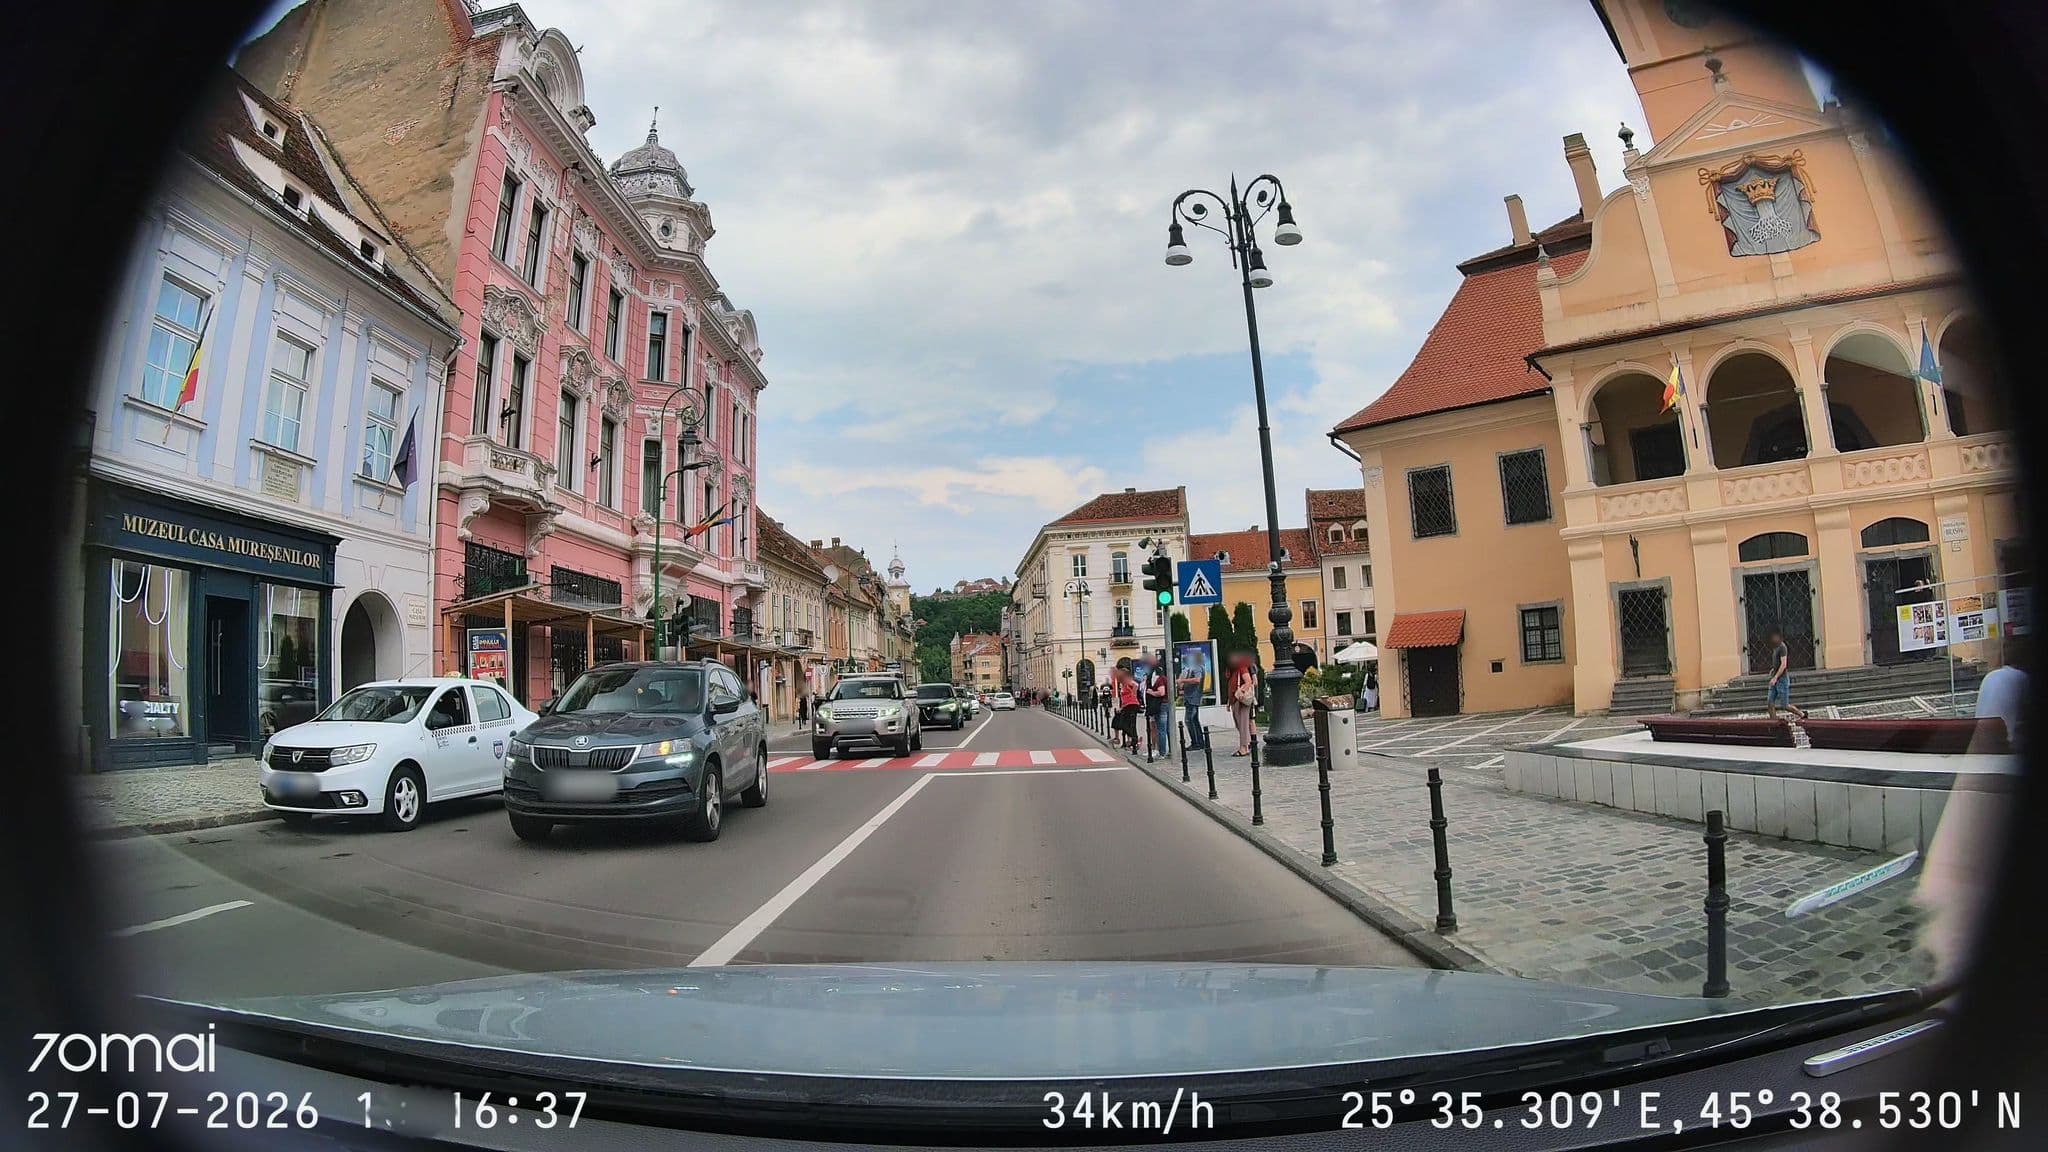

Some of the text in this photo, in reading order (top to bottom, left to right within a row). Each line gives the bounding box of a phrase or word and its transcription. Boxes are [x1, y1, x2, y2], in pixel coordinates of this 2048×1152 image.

[122, 513, 321, 569] MUZEUL CASA MUREȘENILOR
